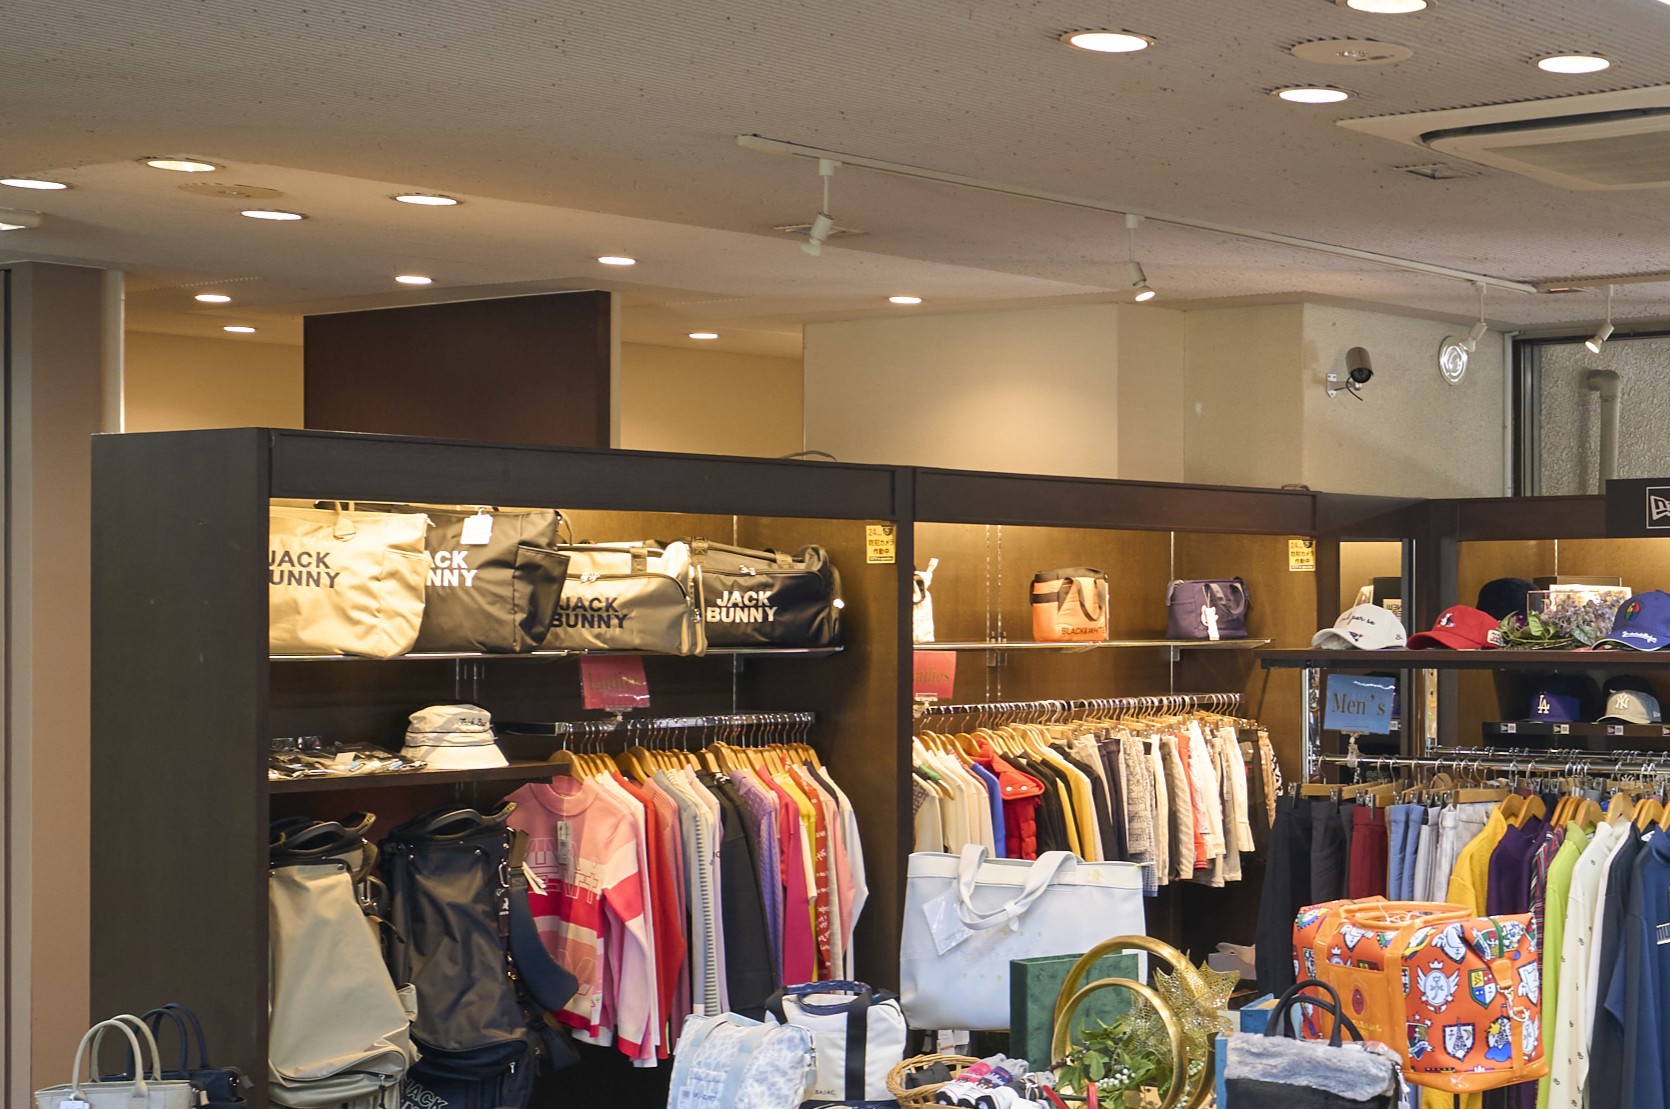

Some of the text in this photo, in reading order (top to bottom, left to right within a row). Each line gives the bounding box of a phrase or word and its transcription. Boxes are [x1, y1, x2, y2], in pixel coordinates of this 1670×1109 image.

[269, 570, 340, 588] UNNY
[426, 570, 478, 587] NNY
[559, 597, 619, 613] JACK
[716, 590, 773, 607] JACK
[551, 611, 629, 629] BUNNY
[706, 606, 778, 623] BUNNY
